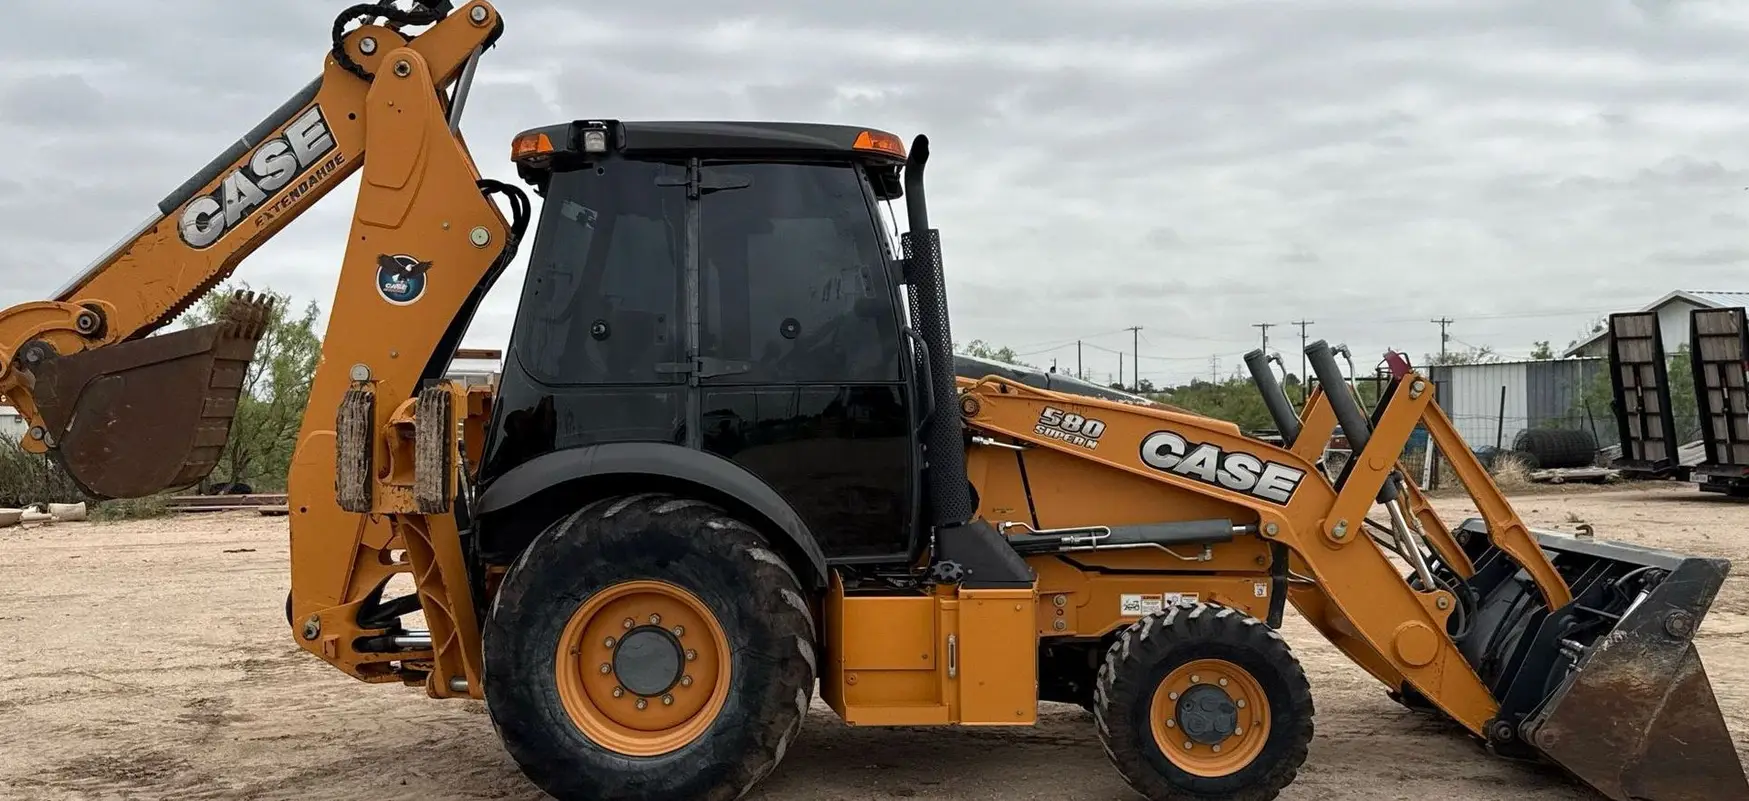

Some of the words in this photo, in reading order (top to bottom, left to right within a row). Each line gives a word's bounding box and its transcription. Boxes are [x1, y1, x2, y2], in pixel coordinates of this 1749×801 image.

[179, 104, 336, 248] CASE
[255, 152, 346, 229] EXTENDAHOE
[1039, 406, 1107, 439] 580
[1140, 430, 1307, 506] CASE
